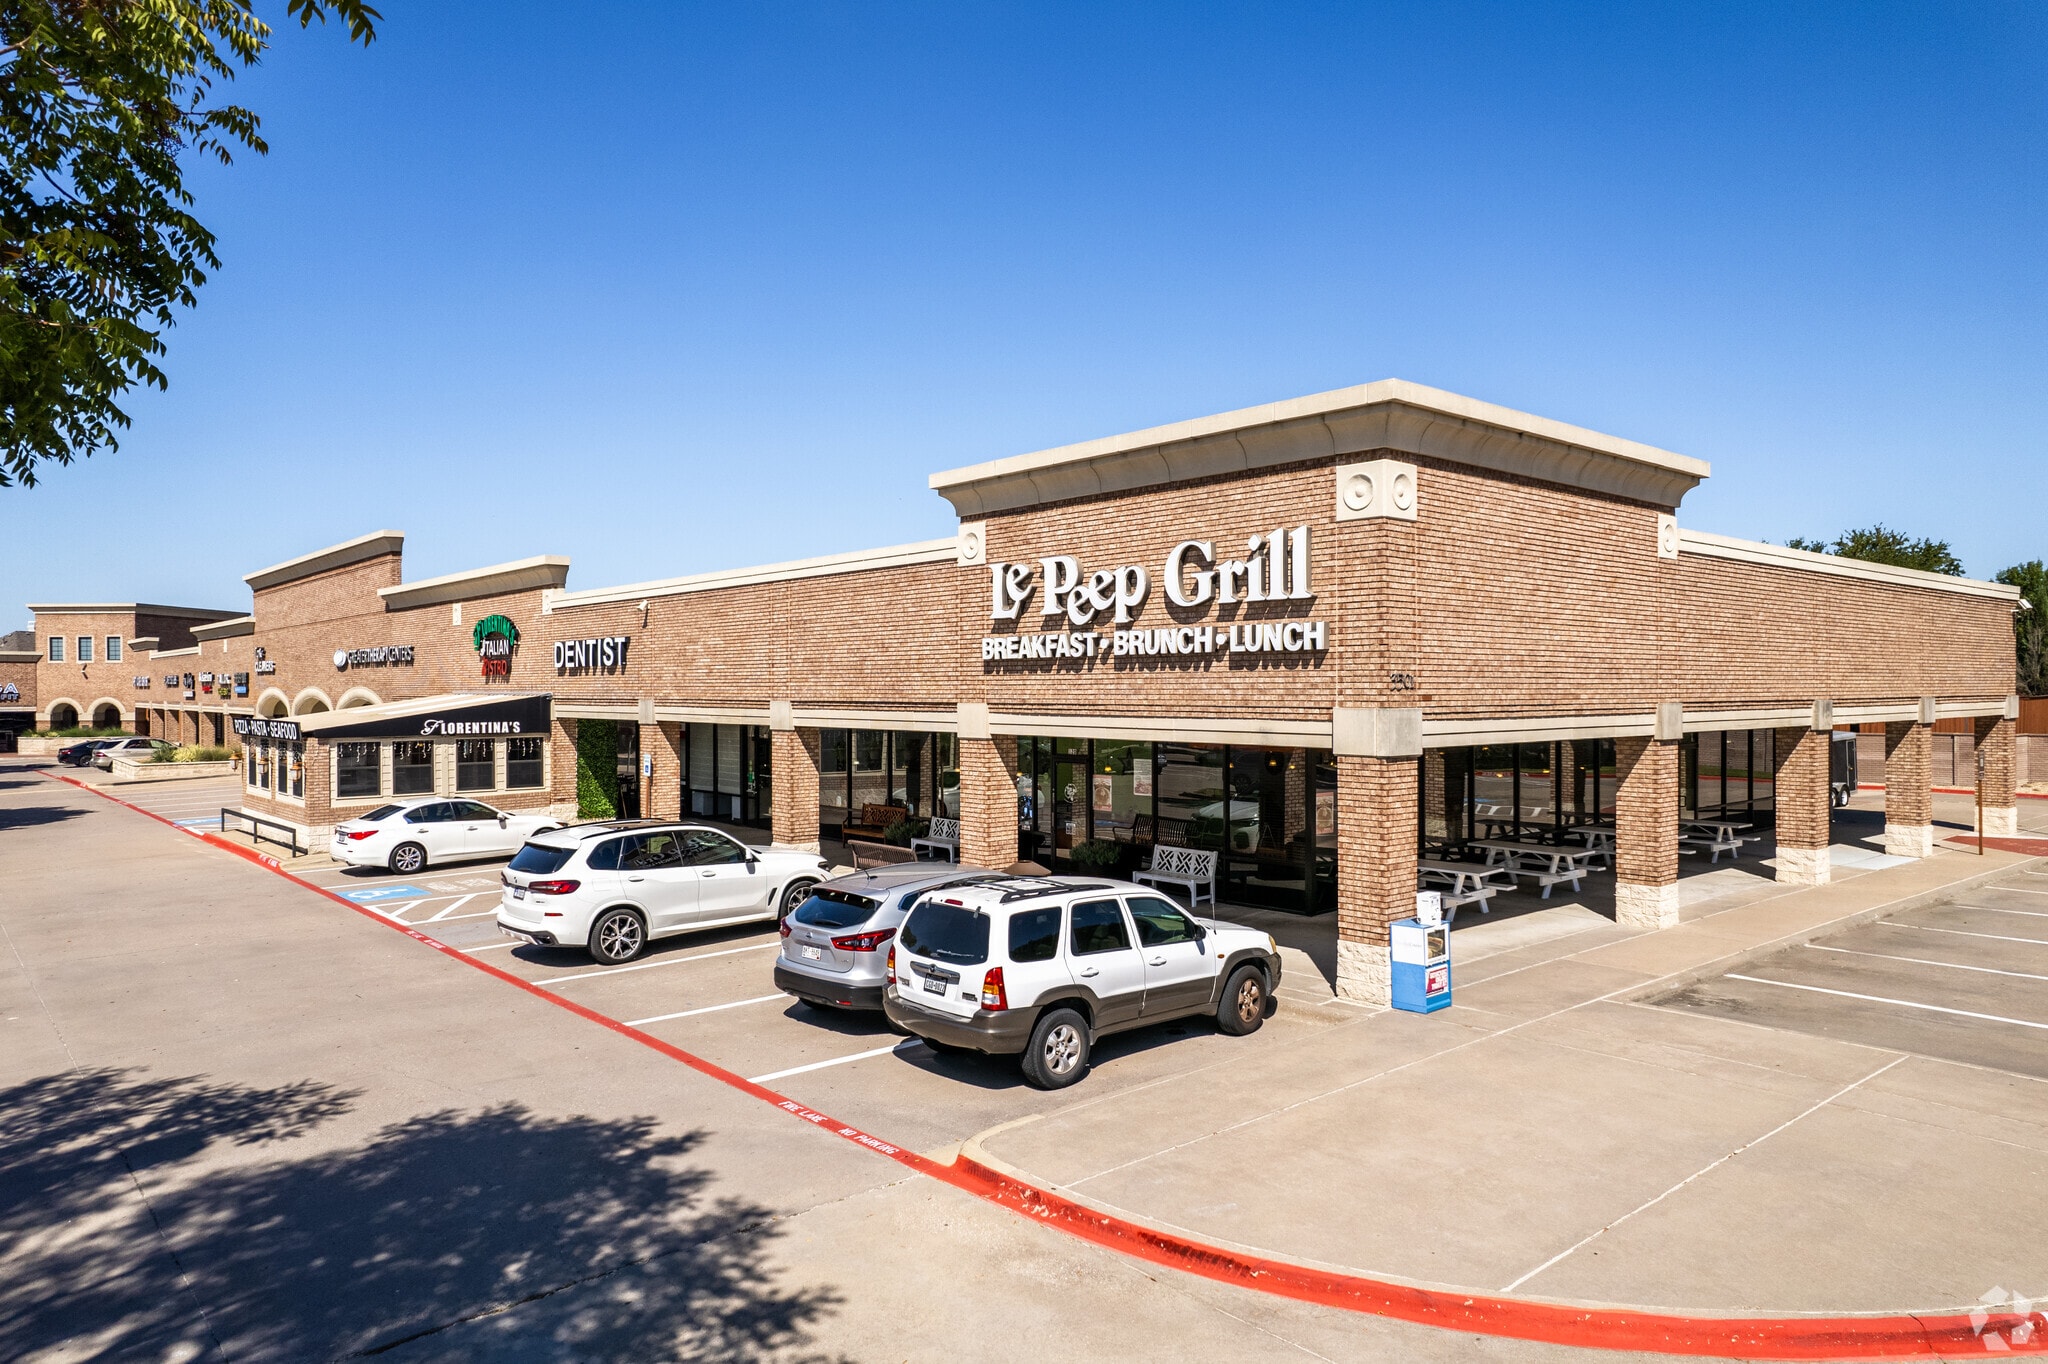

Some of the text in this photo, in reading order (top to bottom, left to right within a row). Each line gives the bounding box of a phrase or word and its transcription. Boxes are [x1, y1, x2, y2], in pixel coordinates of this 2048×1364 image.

[989, 524, 1314, 625] Le Peep Grill
[480, 638, 509, 656] ITALIAN
[554, 637, 626, 667] DENTIST
[982, 621, 1328, 660] BREAKFAST BRUNCH LUNCH
[482, 657, 508, 676] BISTRO
[234, 719, 297, 740] PIZZA PASTA SEAFOOD
[421, 719, 520, 735] FLORENTINA'S
[778, 1100, 899, 1155] FIRE LANE NO PARKING
